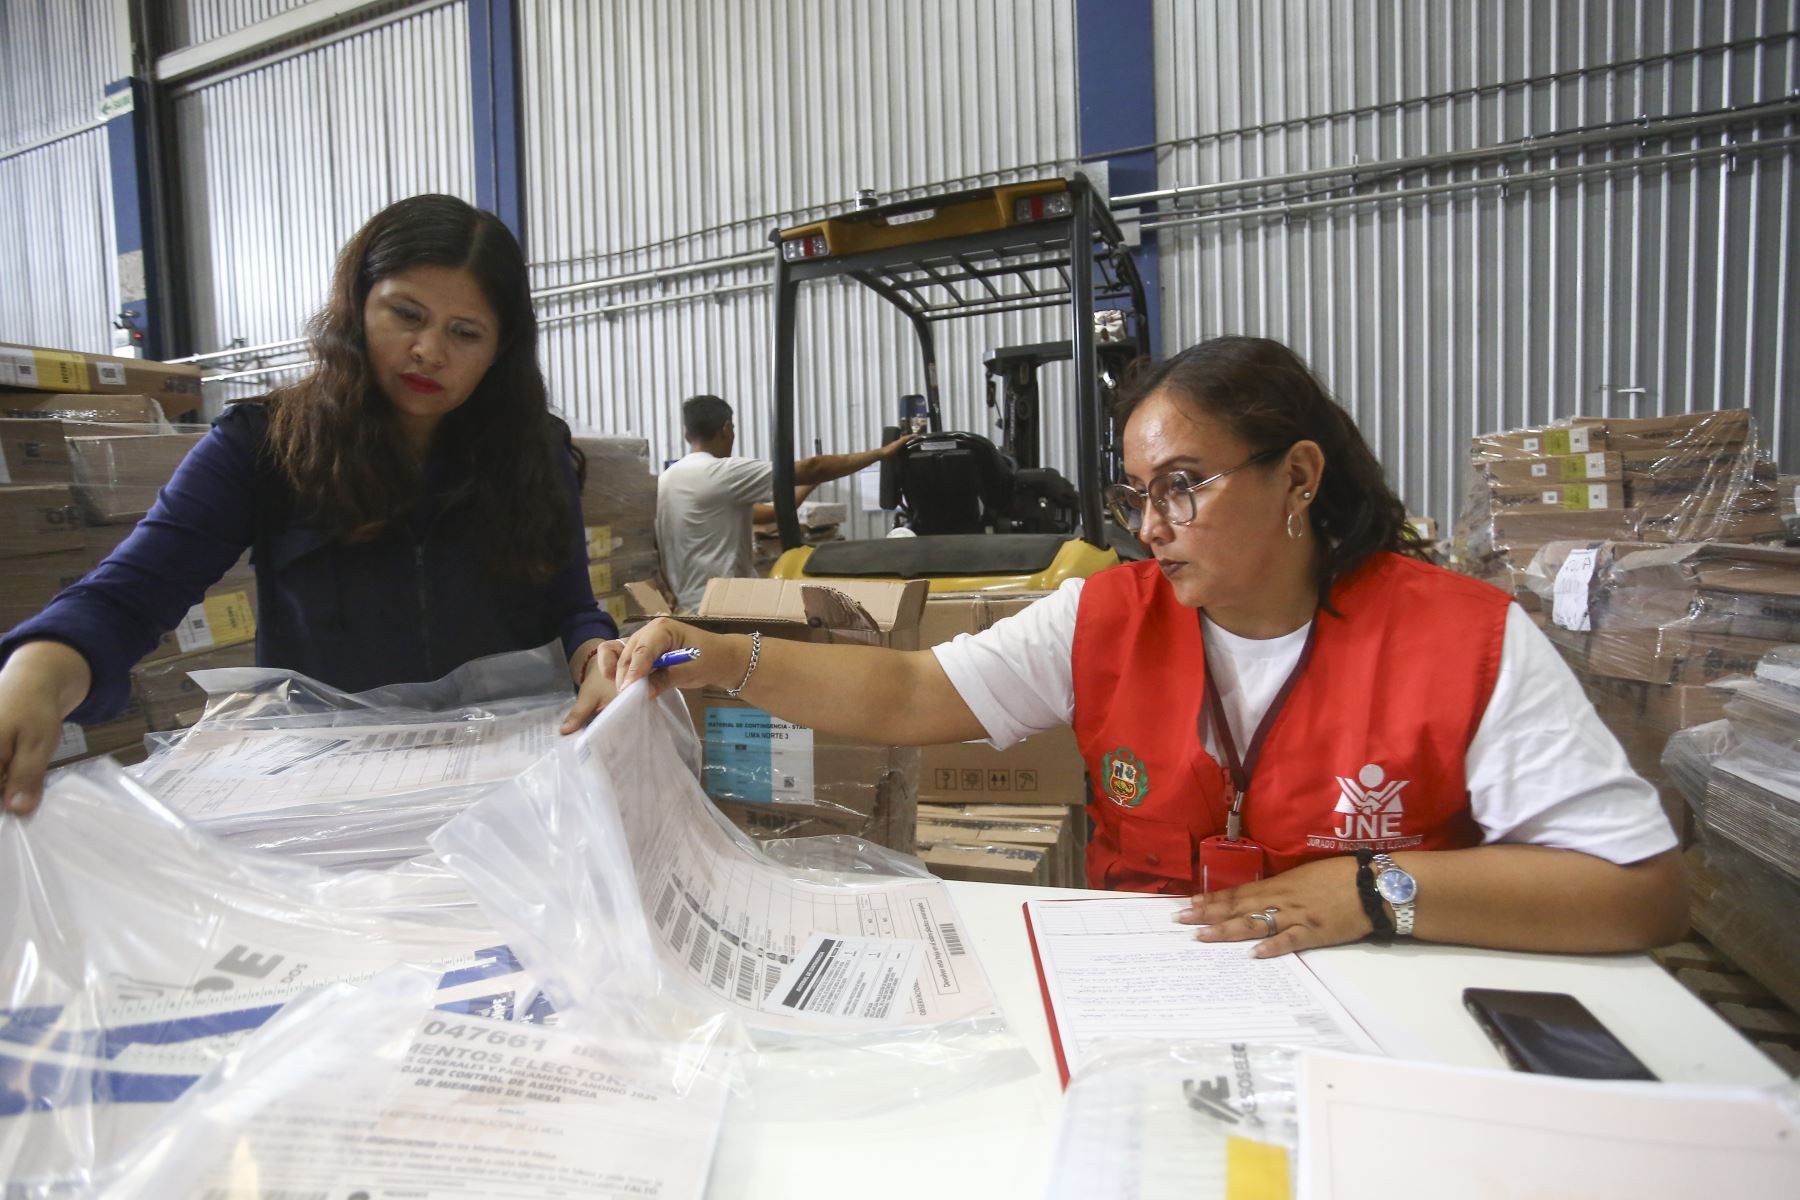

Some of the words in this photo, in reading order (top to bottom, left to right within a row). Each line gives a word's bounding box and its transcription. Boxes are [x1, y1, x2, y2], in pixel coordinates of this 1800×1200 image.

[1334, 813, 1403, 839] JNE
[1307, 837, 1336, 849] JURADO
[940, 968, 951, 987] Devolver
[423, 1021, 548, 1052] 047661
[401, 1065, 425, 1074] OJA
[428, 1067, 446, 1077] DE
[448, 1070, 504, 1084] CONTROL
[507, 1077, 524, 1087] DE
[528, 1080, 598, 1099] ASISTENCIA
[417, 1057, 485, 1071] GENERALES
[499, 1067, 578, 1086] PARLAMENTO
[581, 1081, 627, 1095] ANDINO
[414, 1078, 432, 1087] DE
[434, 1080, 504, 1096] MIEMBROS
[505, 1088, 524, 1098] DE
[525, 1091, 562, 1103] MESA
